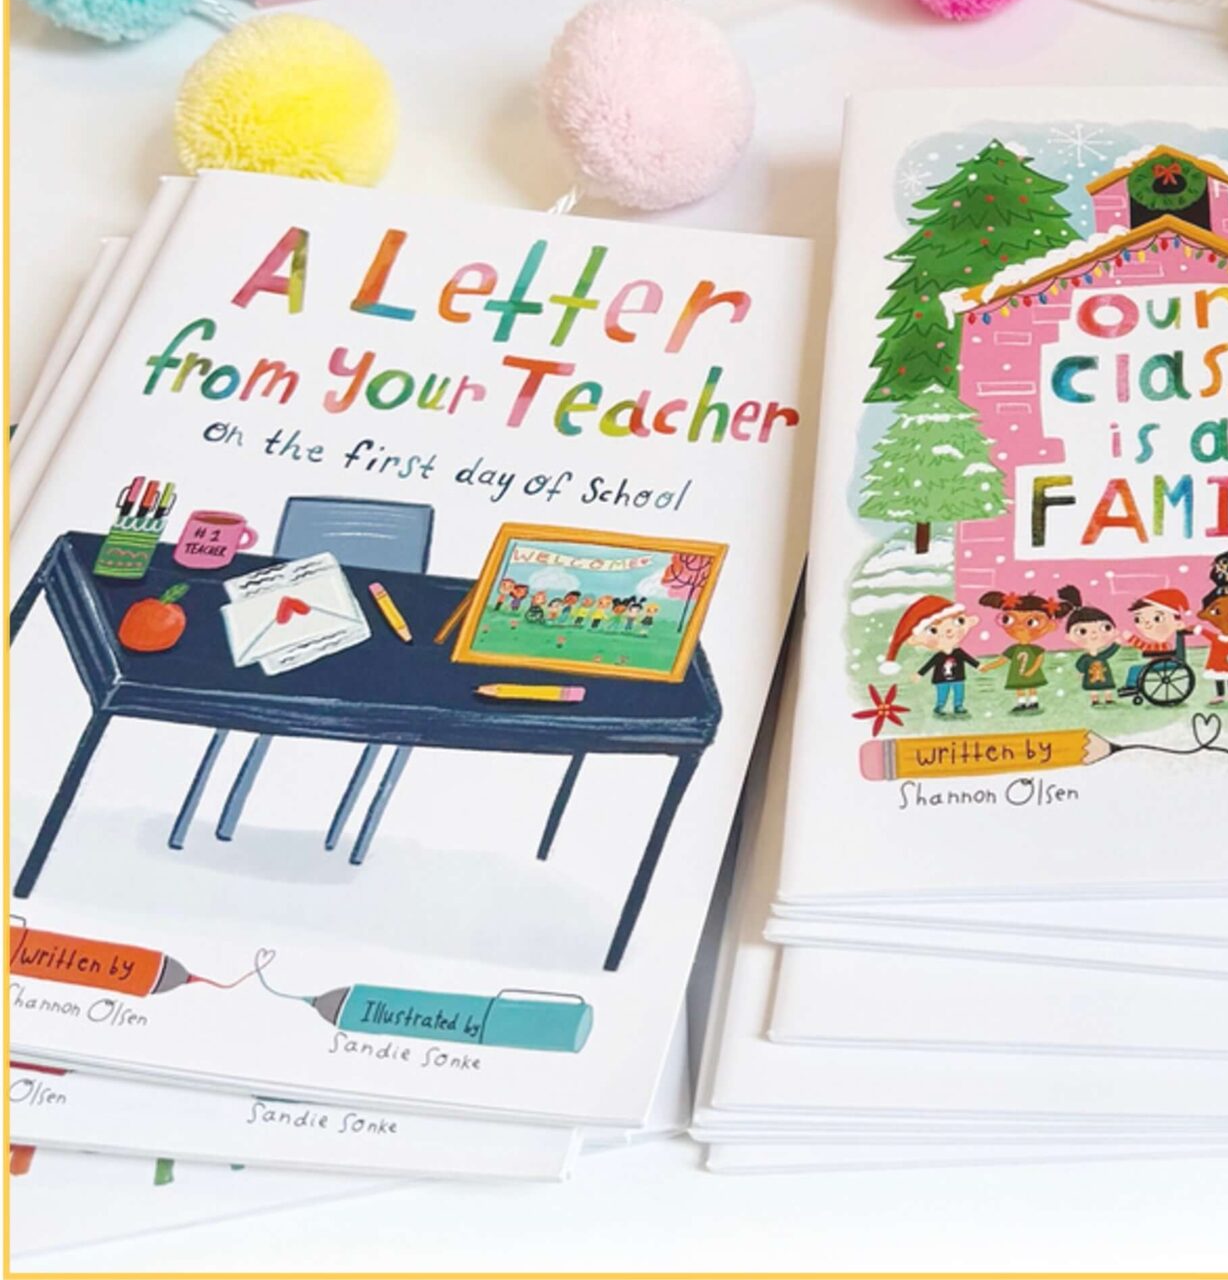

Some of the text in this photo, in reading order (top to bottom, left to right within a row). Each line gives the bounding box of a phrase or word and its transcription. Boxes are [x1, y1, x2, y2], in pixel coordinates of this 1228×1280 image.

[231, 226, 752, 354] A Letter
[143, 318, 299, 404] from
[501, 356, 799, 444] Teacher
[1109, 422, 1161, 464] is
[202, 421, 693, 512] on the first day of School
[513, 548, 641, 570] WELCOME
[916, 739, 1052, 766] written by
[899, 777, 1079, 810] Shannon Olsen
[20, 946, 136, 980] written by
[87, 997, 148, 1026] Olsen
[361, 1000, 481, 1038] Illustrated by
[329, 1032, 481, 1071] Sandie Sonke
[9, 1078, 398, 1135] Olsen Sandie Sonke
